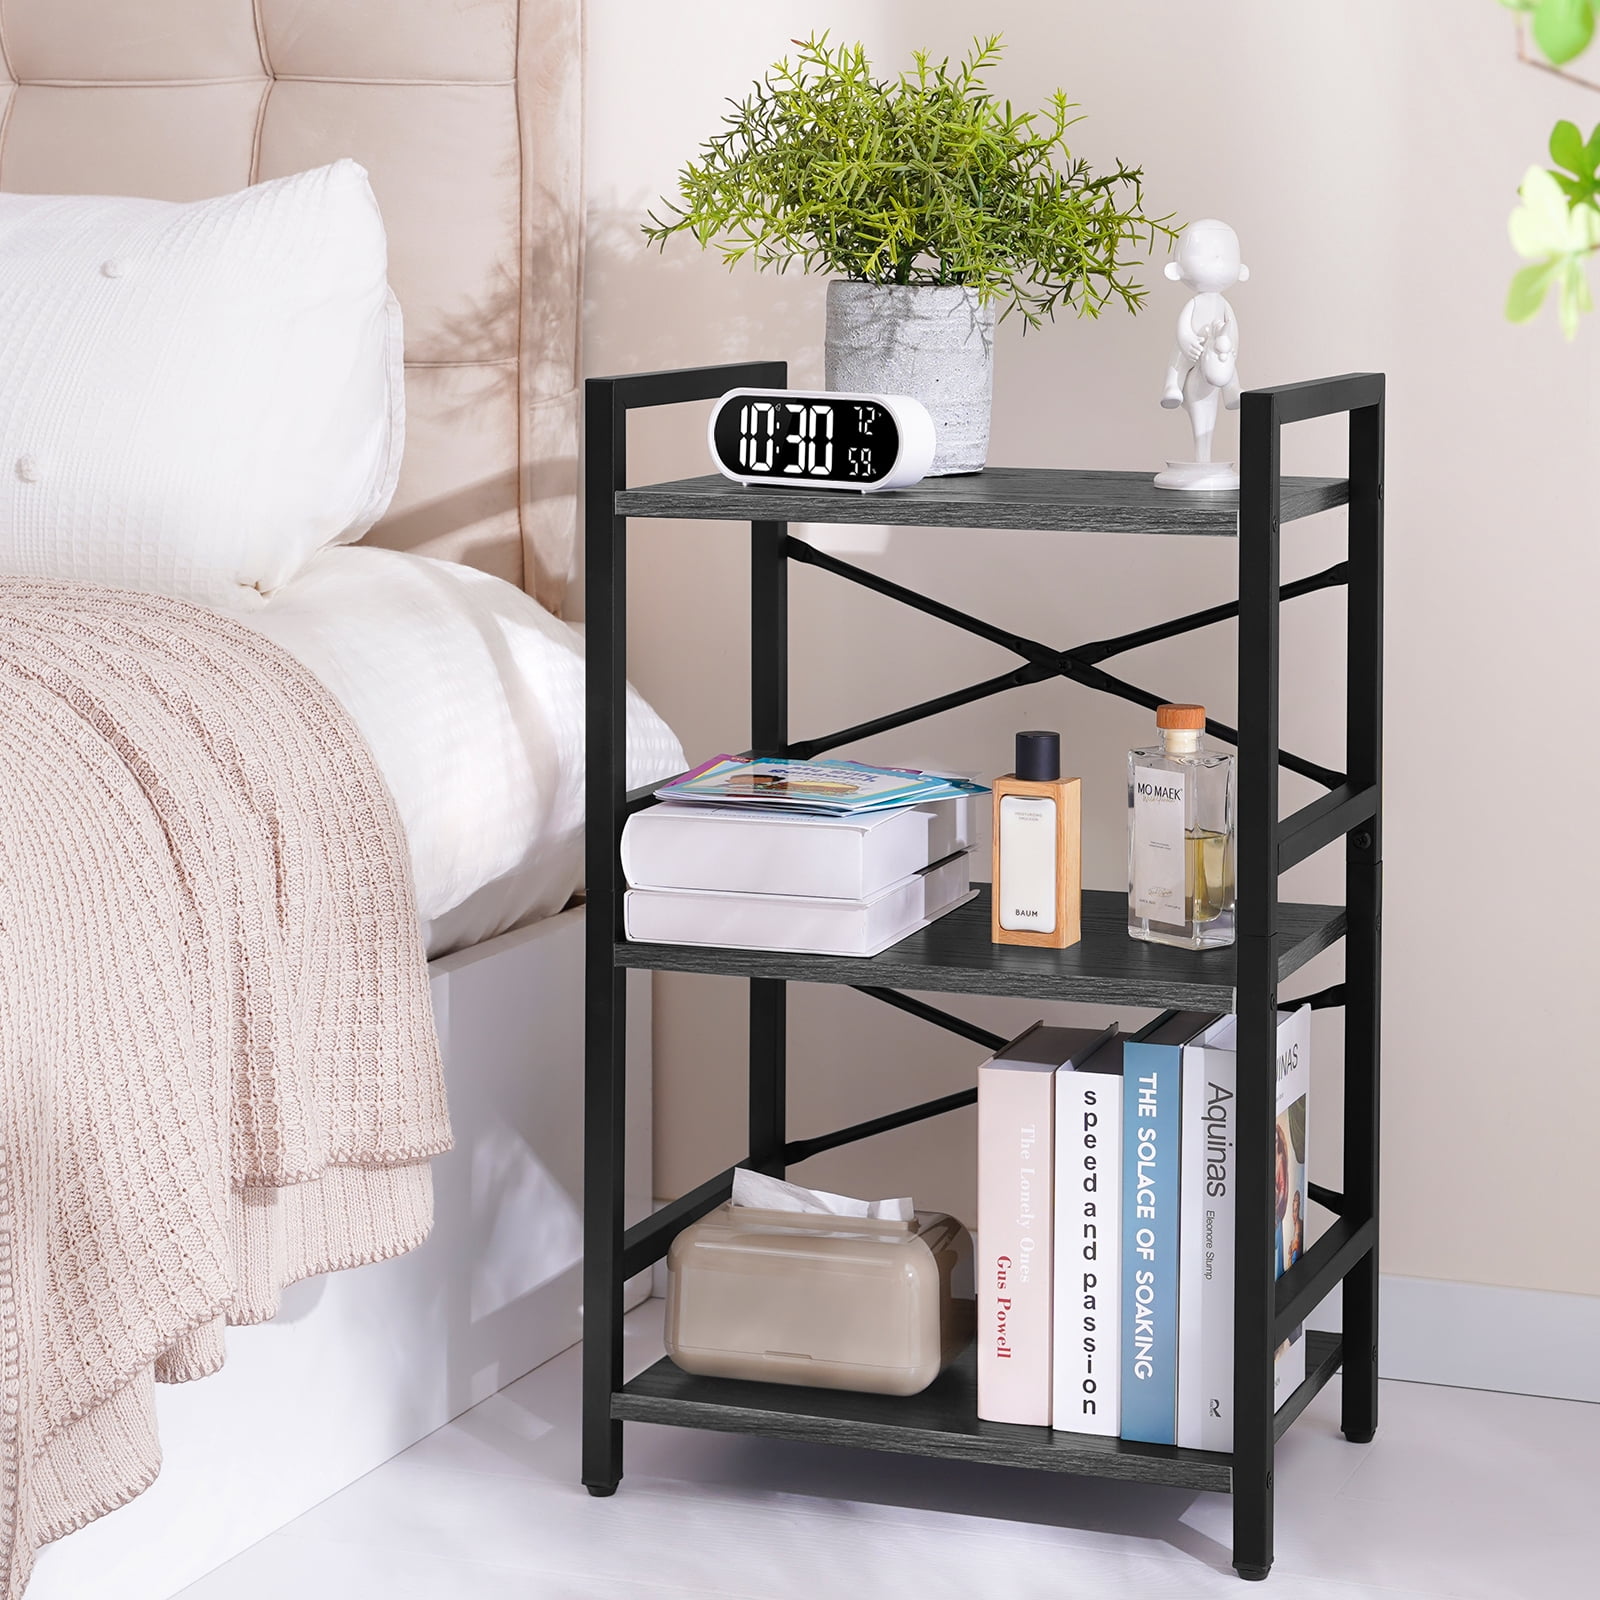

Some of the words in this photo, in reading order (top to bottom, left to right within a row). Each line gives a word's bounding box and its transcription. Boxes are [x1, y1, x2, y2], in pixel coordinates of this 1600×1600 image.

[739, 402, 834, 475] 10:30
[1137, 782, 1153, 796] MO
[1154, 785, 1181, 801] MAEK
[1015, 908, 1039, 918] BAUM
[1138, 1072, 1157, 1118] THE
[1020, 1124, 1036, 1160] The
[1083, 1090, 1098, 1193] speed
[1201, 1081, 1234, 1198] Aquinas
[1016, 1167, 1036, 1229] Lonely
[1136, 1127, 1156, 1219] SOLACE
[1083, 1201, 1097, 1261] and
[1136, 1228, 1155, 1261] OF
[1206, 1210, 1216, 1249] Eleonore
[996, 1255, 1012, 1290] Gus
[1019, 1237, 1035, 1283] Ones
[1204, 1251, 1215, 1281] Stump
[996, 1297, 1012, 1359] Powell
[1083, 1272, 1098, 1416] passion
[1134, 1270, 1154, 1380] SOAKING
